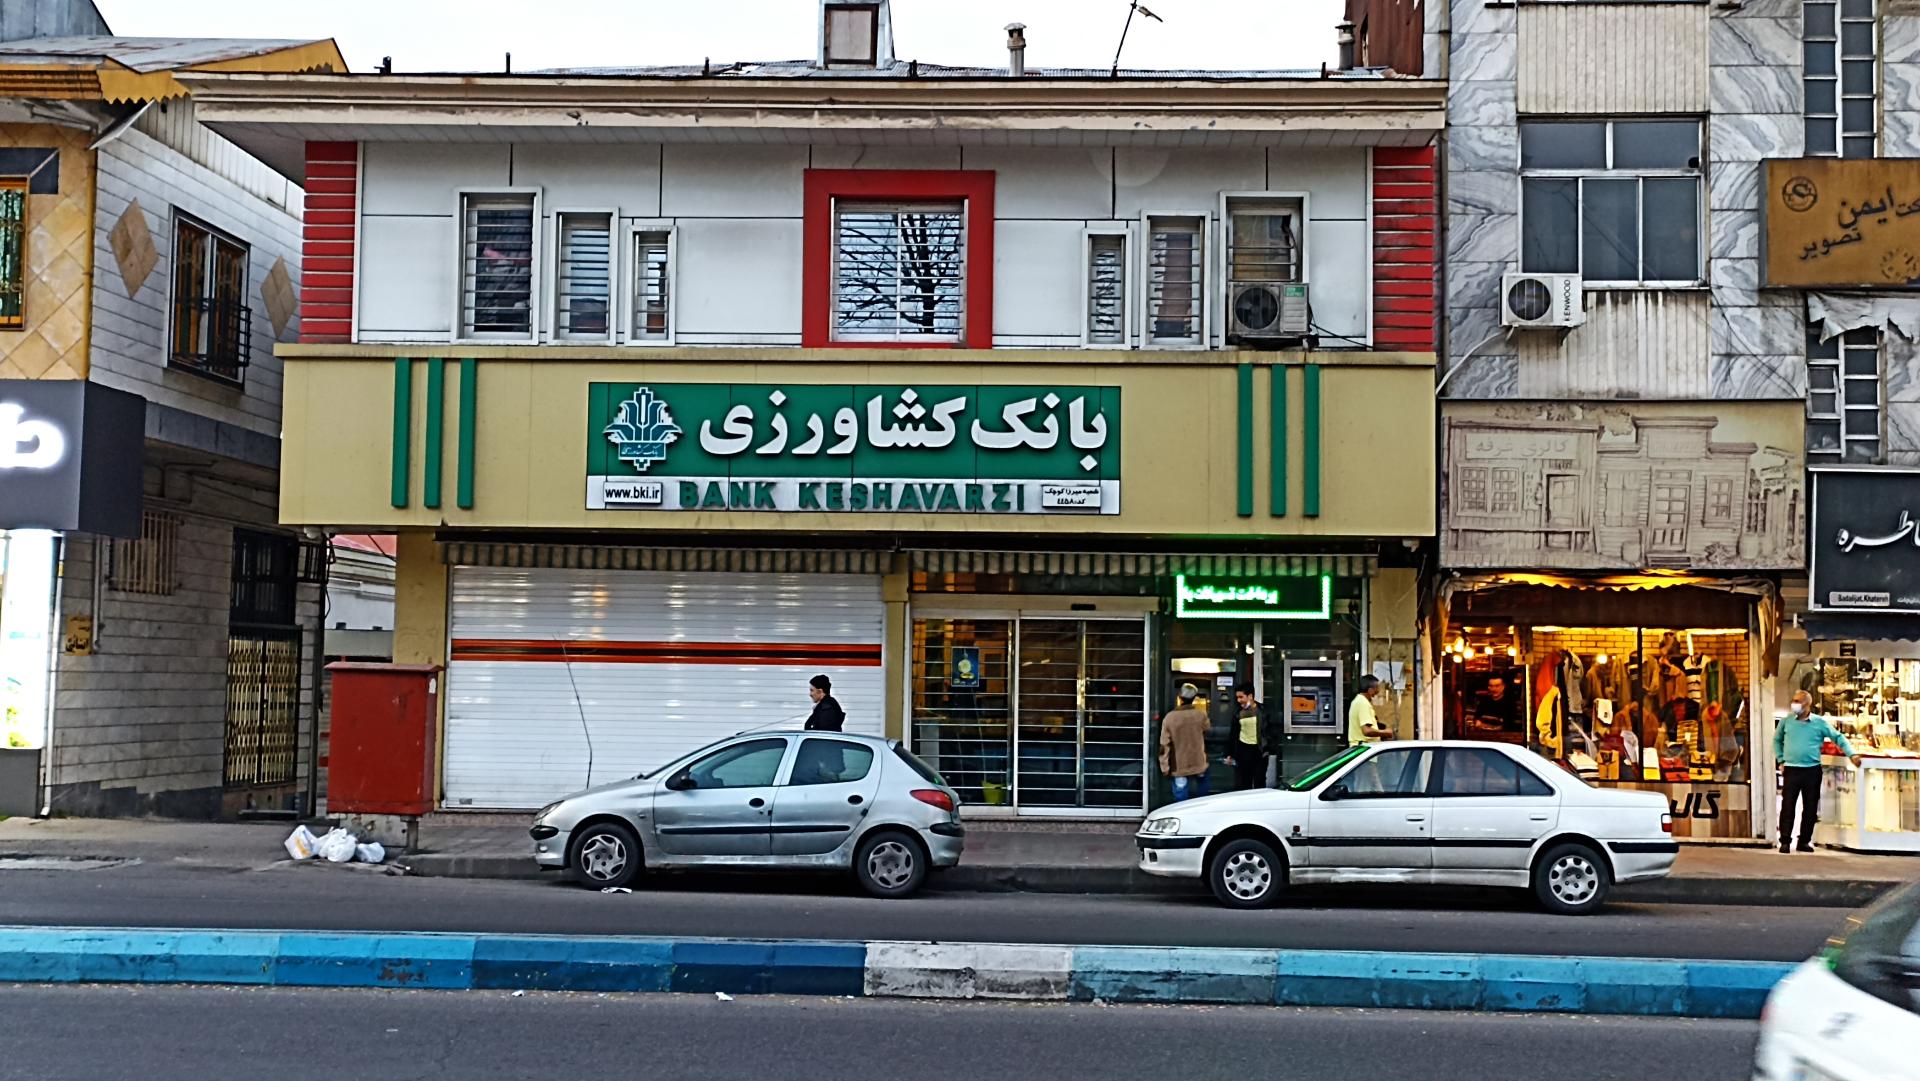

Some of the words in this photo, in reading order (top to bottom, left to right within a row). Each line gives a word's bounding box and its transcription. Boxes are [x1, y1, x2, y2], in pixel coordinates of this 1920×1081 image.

[1838, 185, 1895, 229] ایمن
[1799, 227, 1862, 260] تصویر
[699, 388, 967, 455] کشاورزی
[971, 392, 1108, 472] بانک
[605, 486, 660, 499] www.bki.ir
[679, 480, 777, 509] BANK
[798, 481, 1025, 511] KESHAVARZI
[1837, 510, 1920, 553] اطره
